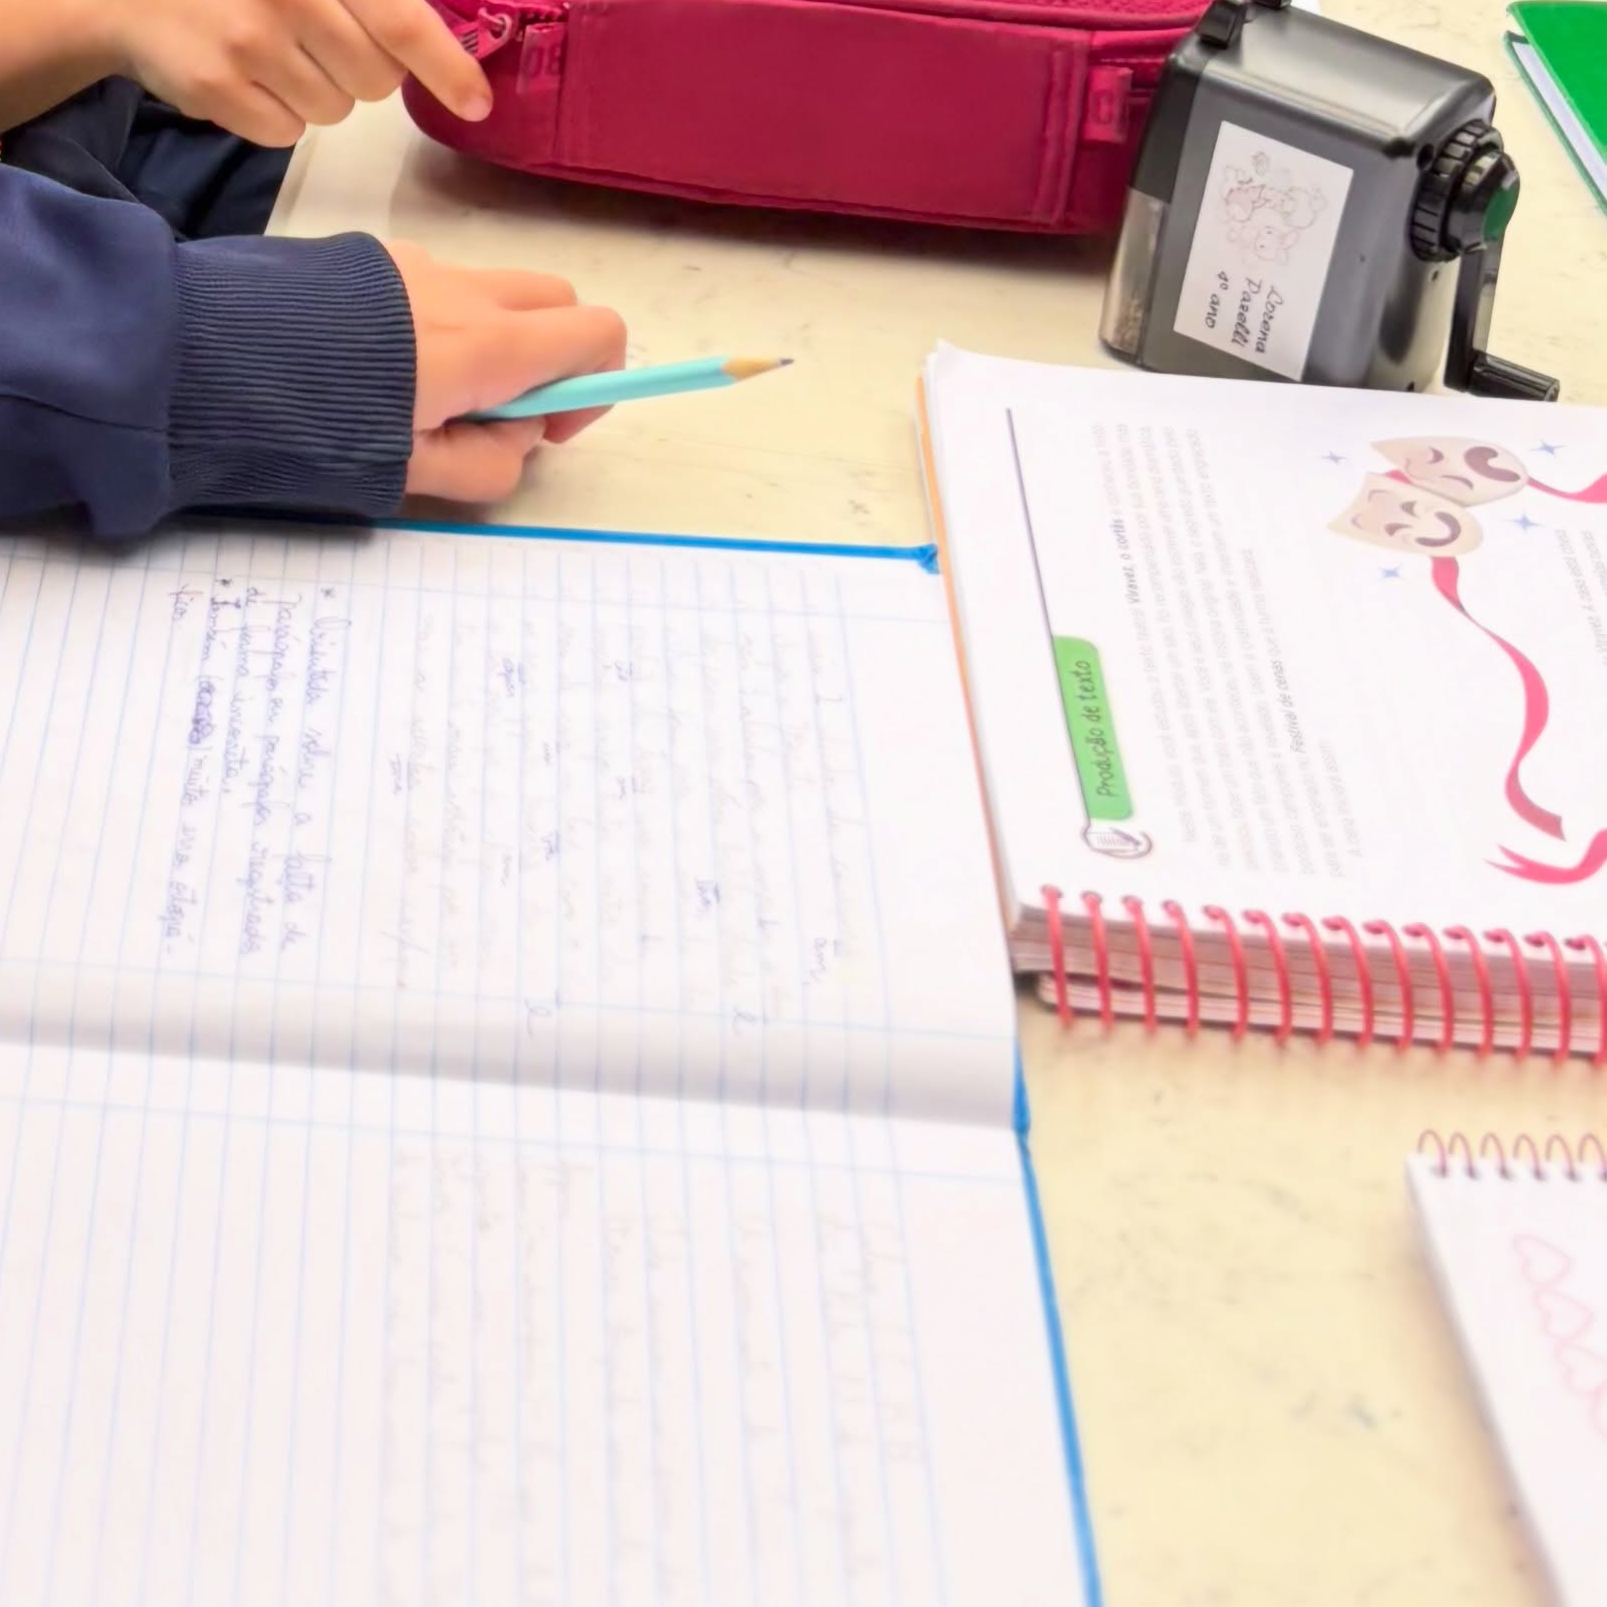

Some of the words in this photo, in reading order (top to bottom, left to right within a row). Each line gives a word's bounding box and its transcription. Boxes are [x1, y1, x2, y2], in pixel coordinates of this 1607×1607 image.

[1205, 294, 1220, 329] ano
[1255, 285, 1284, 353] Lorena
[1069, 660, 1097, 700] texto
[1081, 706, 1101, 722] de
[1085, 728, 1116, 797] Produção
